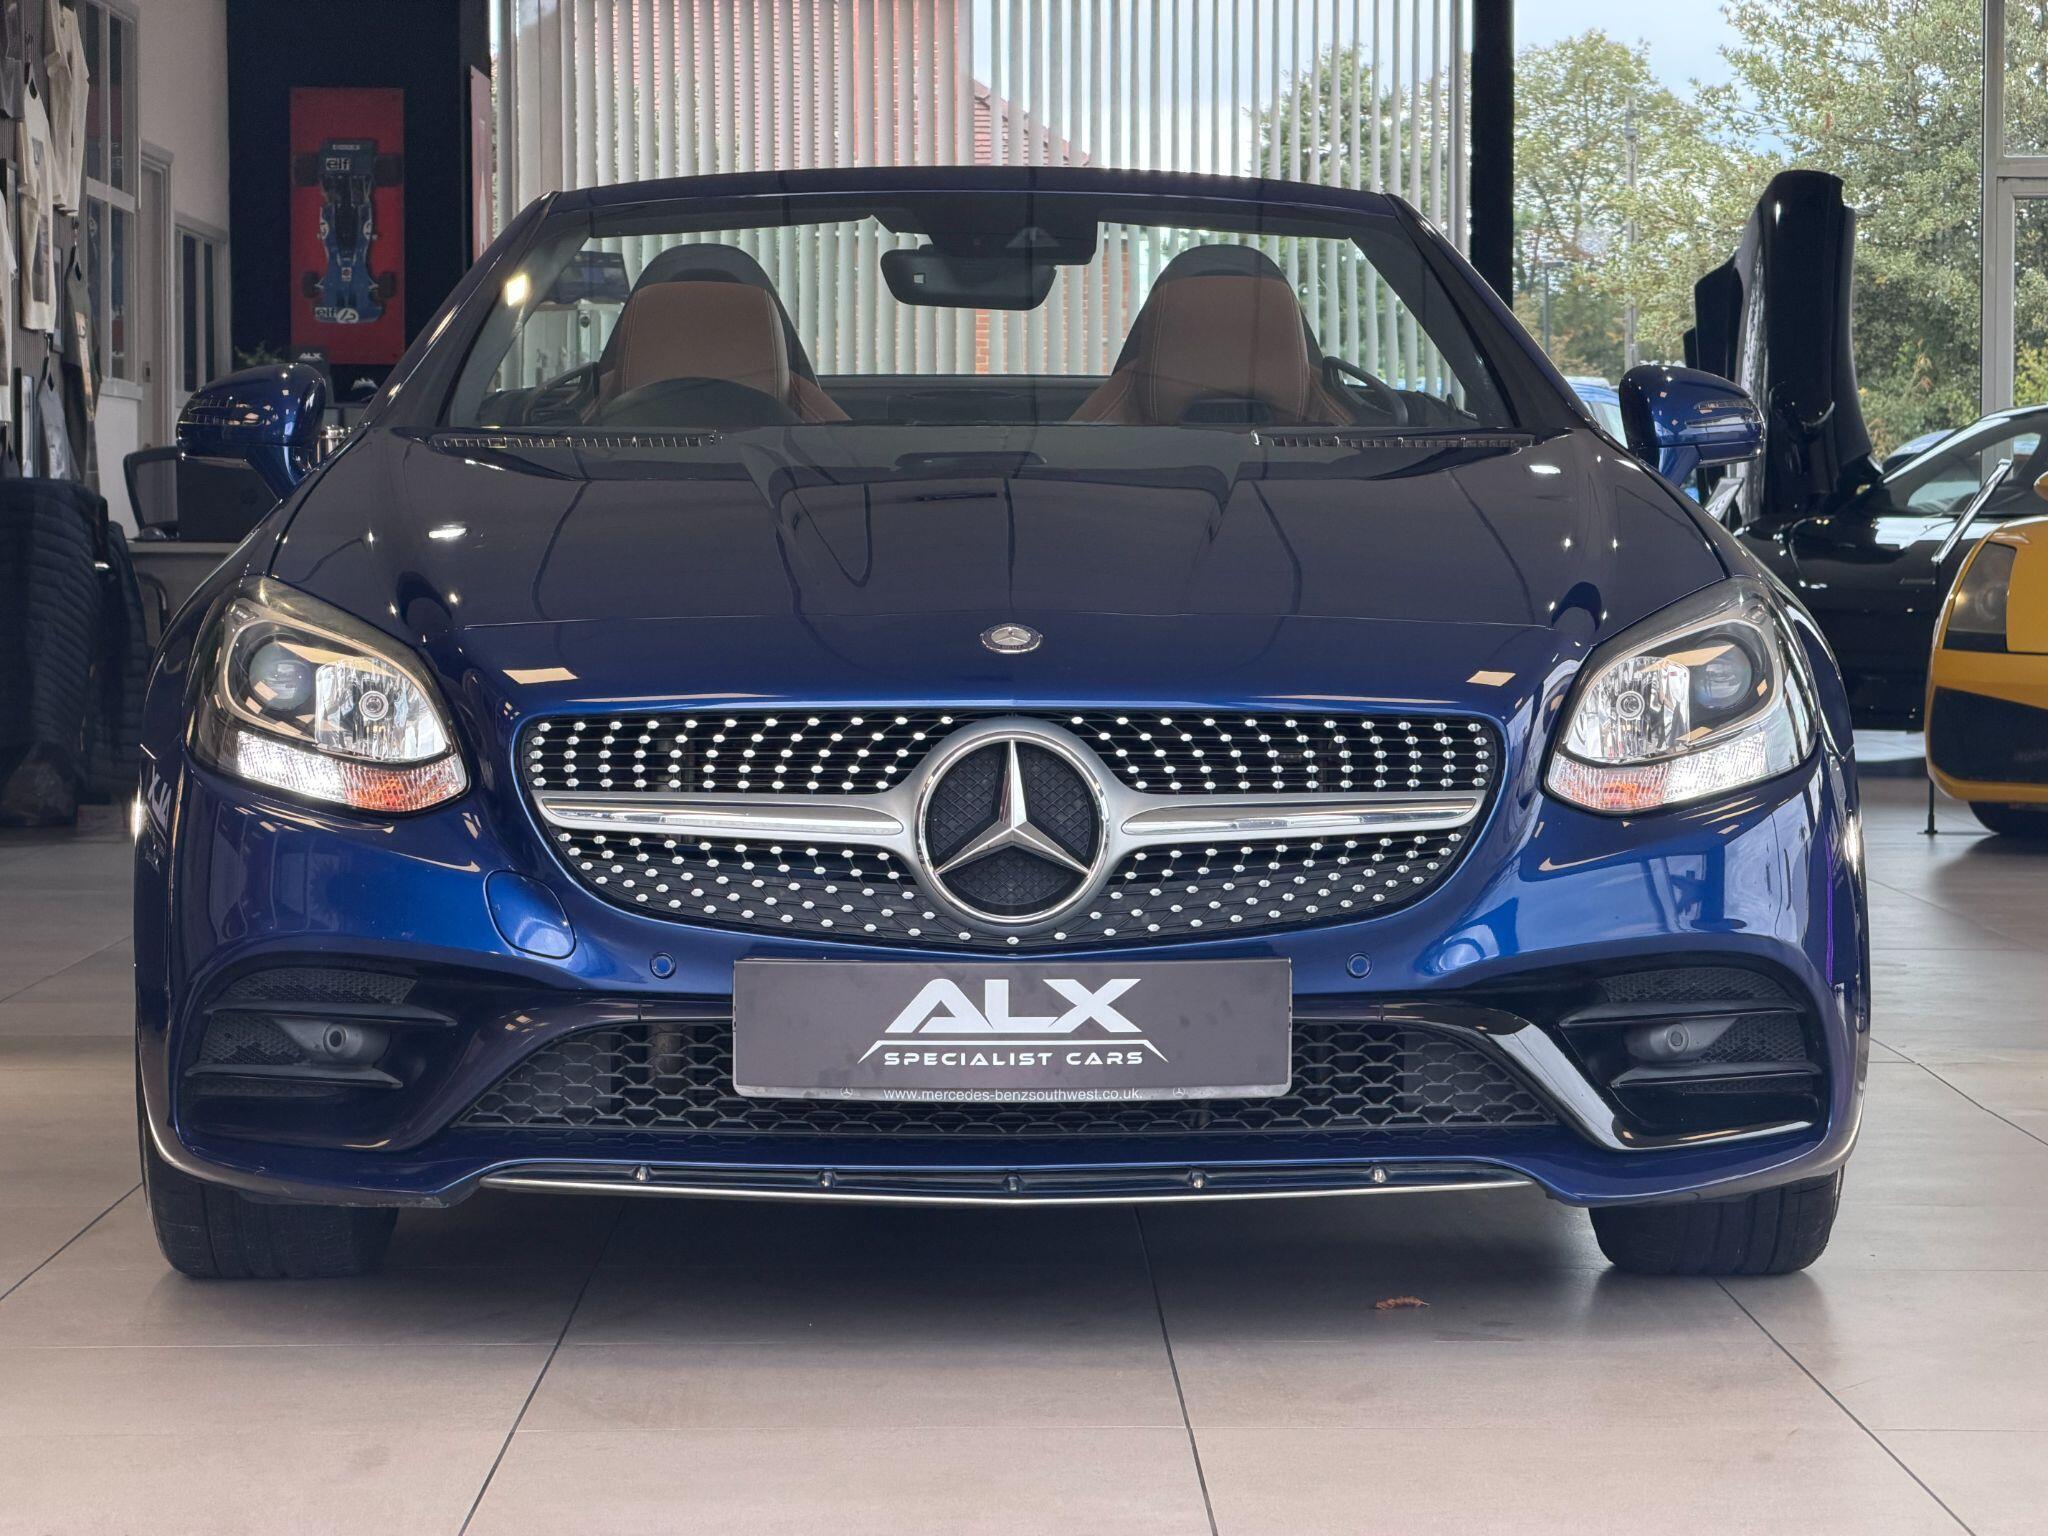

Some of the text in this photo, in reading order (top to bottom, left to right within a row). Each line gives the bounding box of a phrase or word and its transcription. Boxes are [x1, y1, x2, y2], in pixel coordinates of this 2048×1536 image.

[326, 158, 350, 170] elf
[315, 306, 337, 318] elf
[885, 978, 1143, 1034] ALX
[884, 1051, 1143, 1066] SPECIALIST CARS
